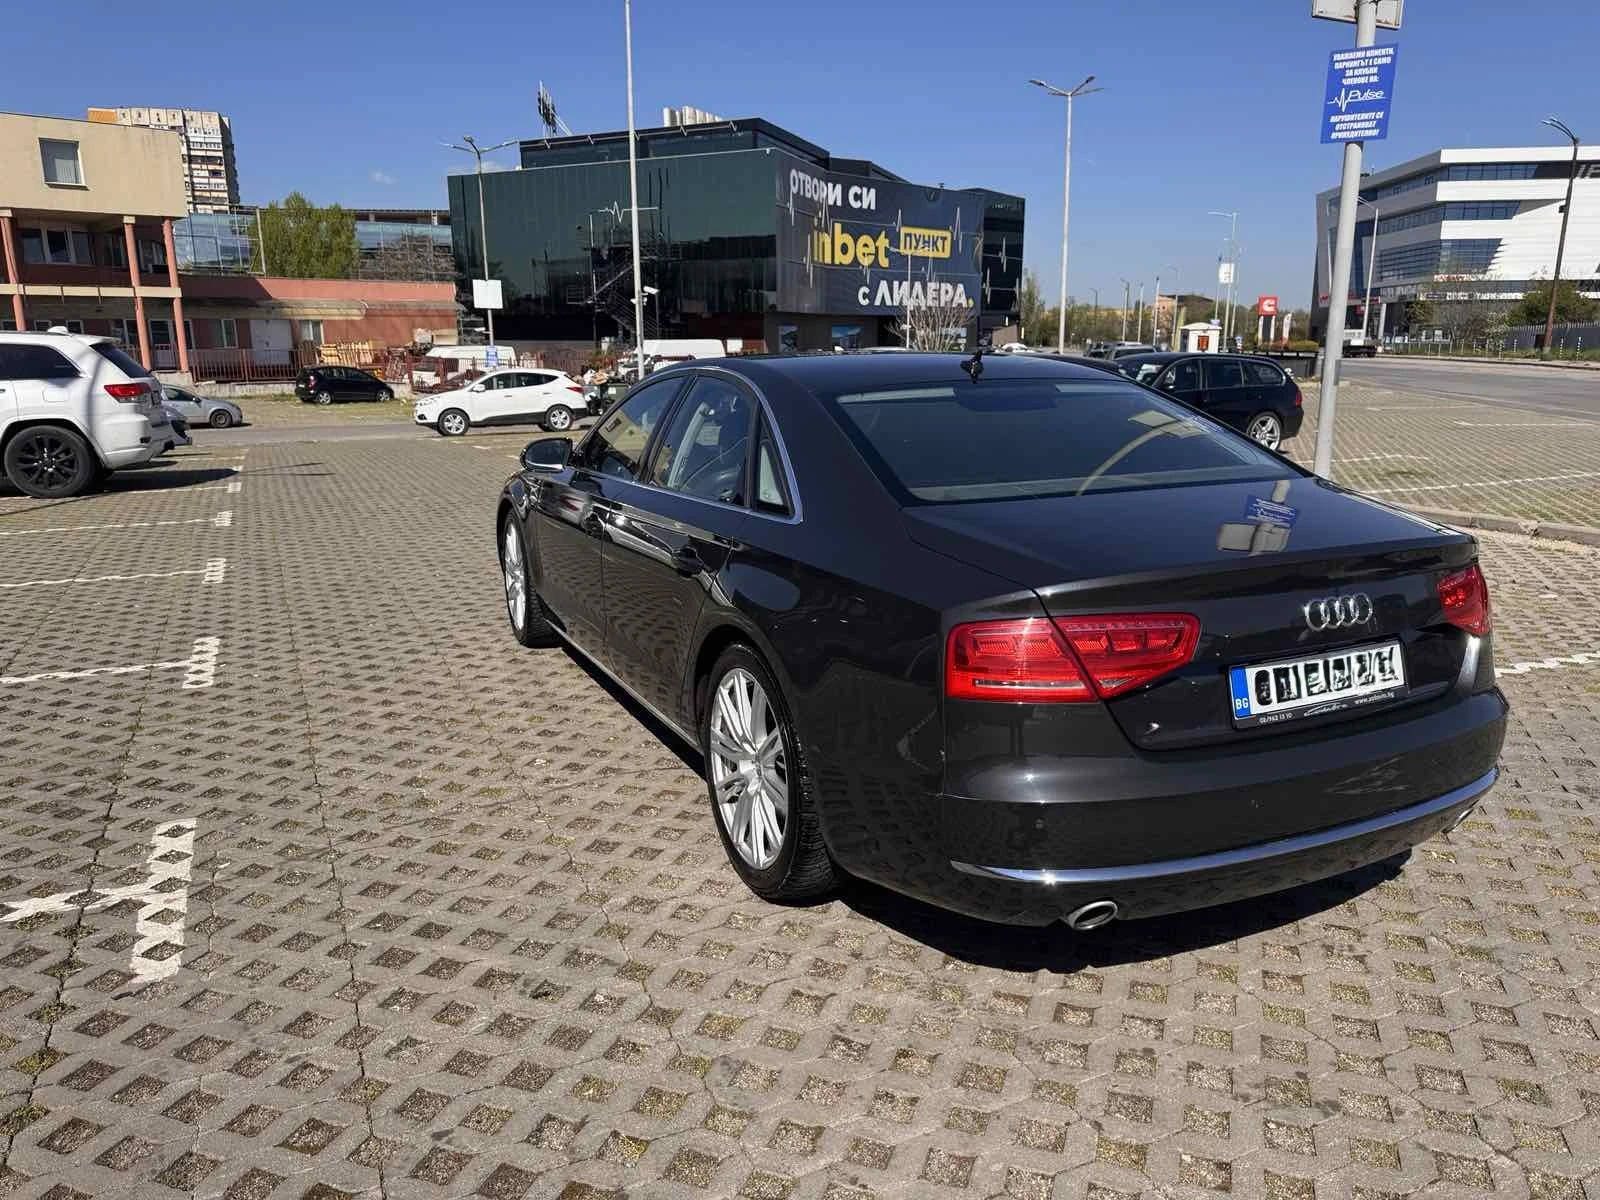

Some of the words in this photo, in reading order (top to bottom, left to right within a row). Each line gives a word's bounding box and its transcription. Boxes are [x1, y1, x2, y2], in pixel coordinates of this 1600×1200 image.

[1373, 56, 1391, 65] САМО
[790, 169, 842, 207] ОТВОРИ
[848, 185, 876, 210] СИ
[813, 218, 889, 268] inbet
[903, 231, 949, 254] ПУНКТ
[1235, 697, 1249, 710] BG
